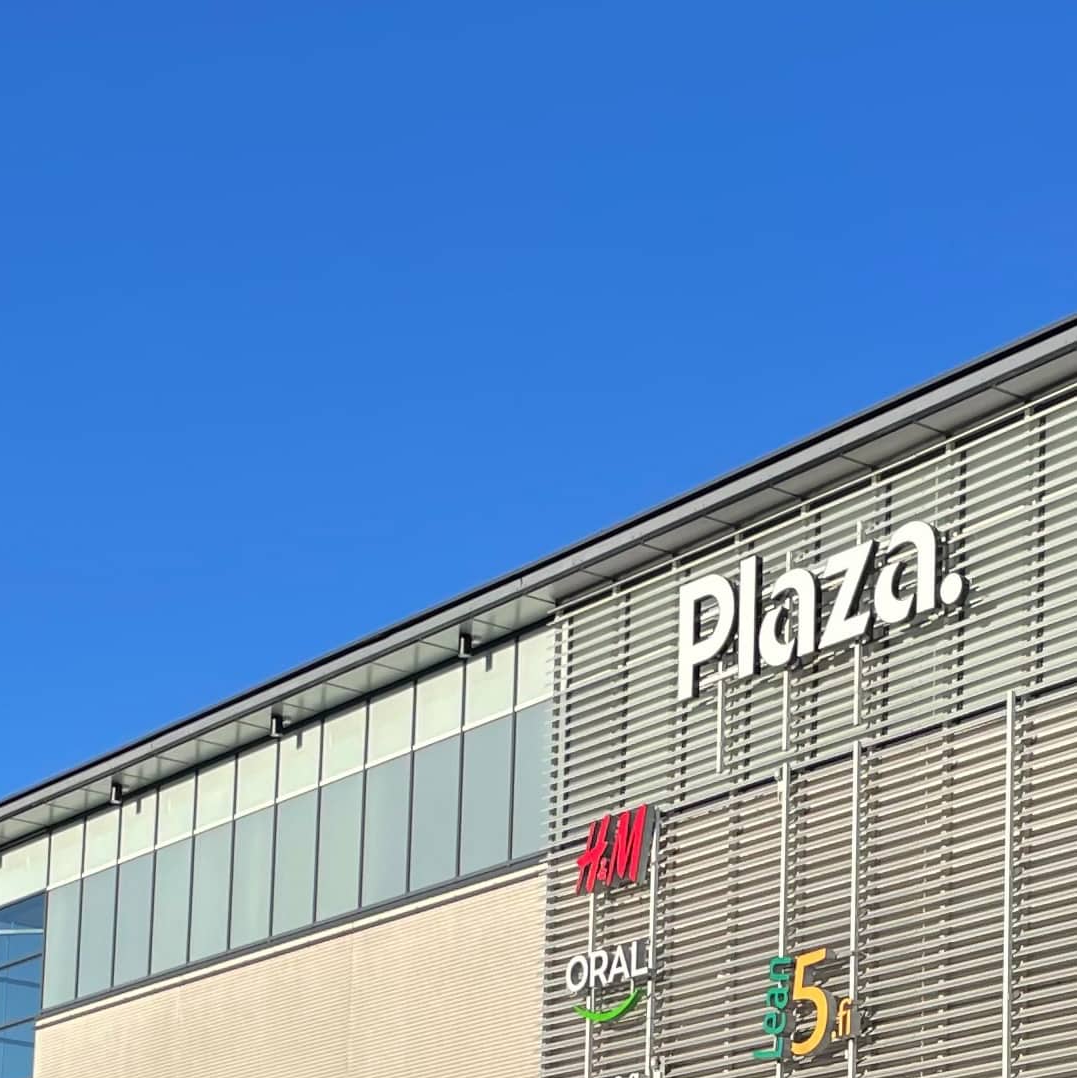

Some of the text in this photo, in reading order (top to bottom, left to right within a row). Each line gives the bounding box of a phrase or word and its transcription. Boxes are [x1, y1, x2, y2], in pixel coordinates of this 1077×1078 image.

[677, 521, 964, 700] Plaza.
[575, 803, 647, 896] H&M
[565, 941, 649, 993] ORAL
[752, 956, 792, 1059] Lean
